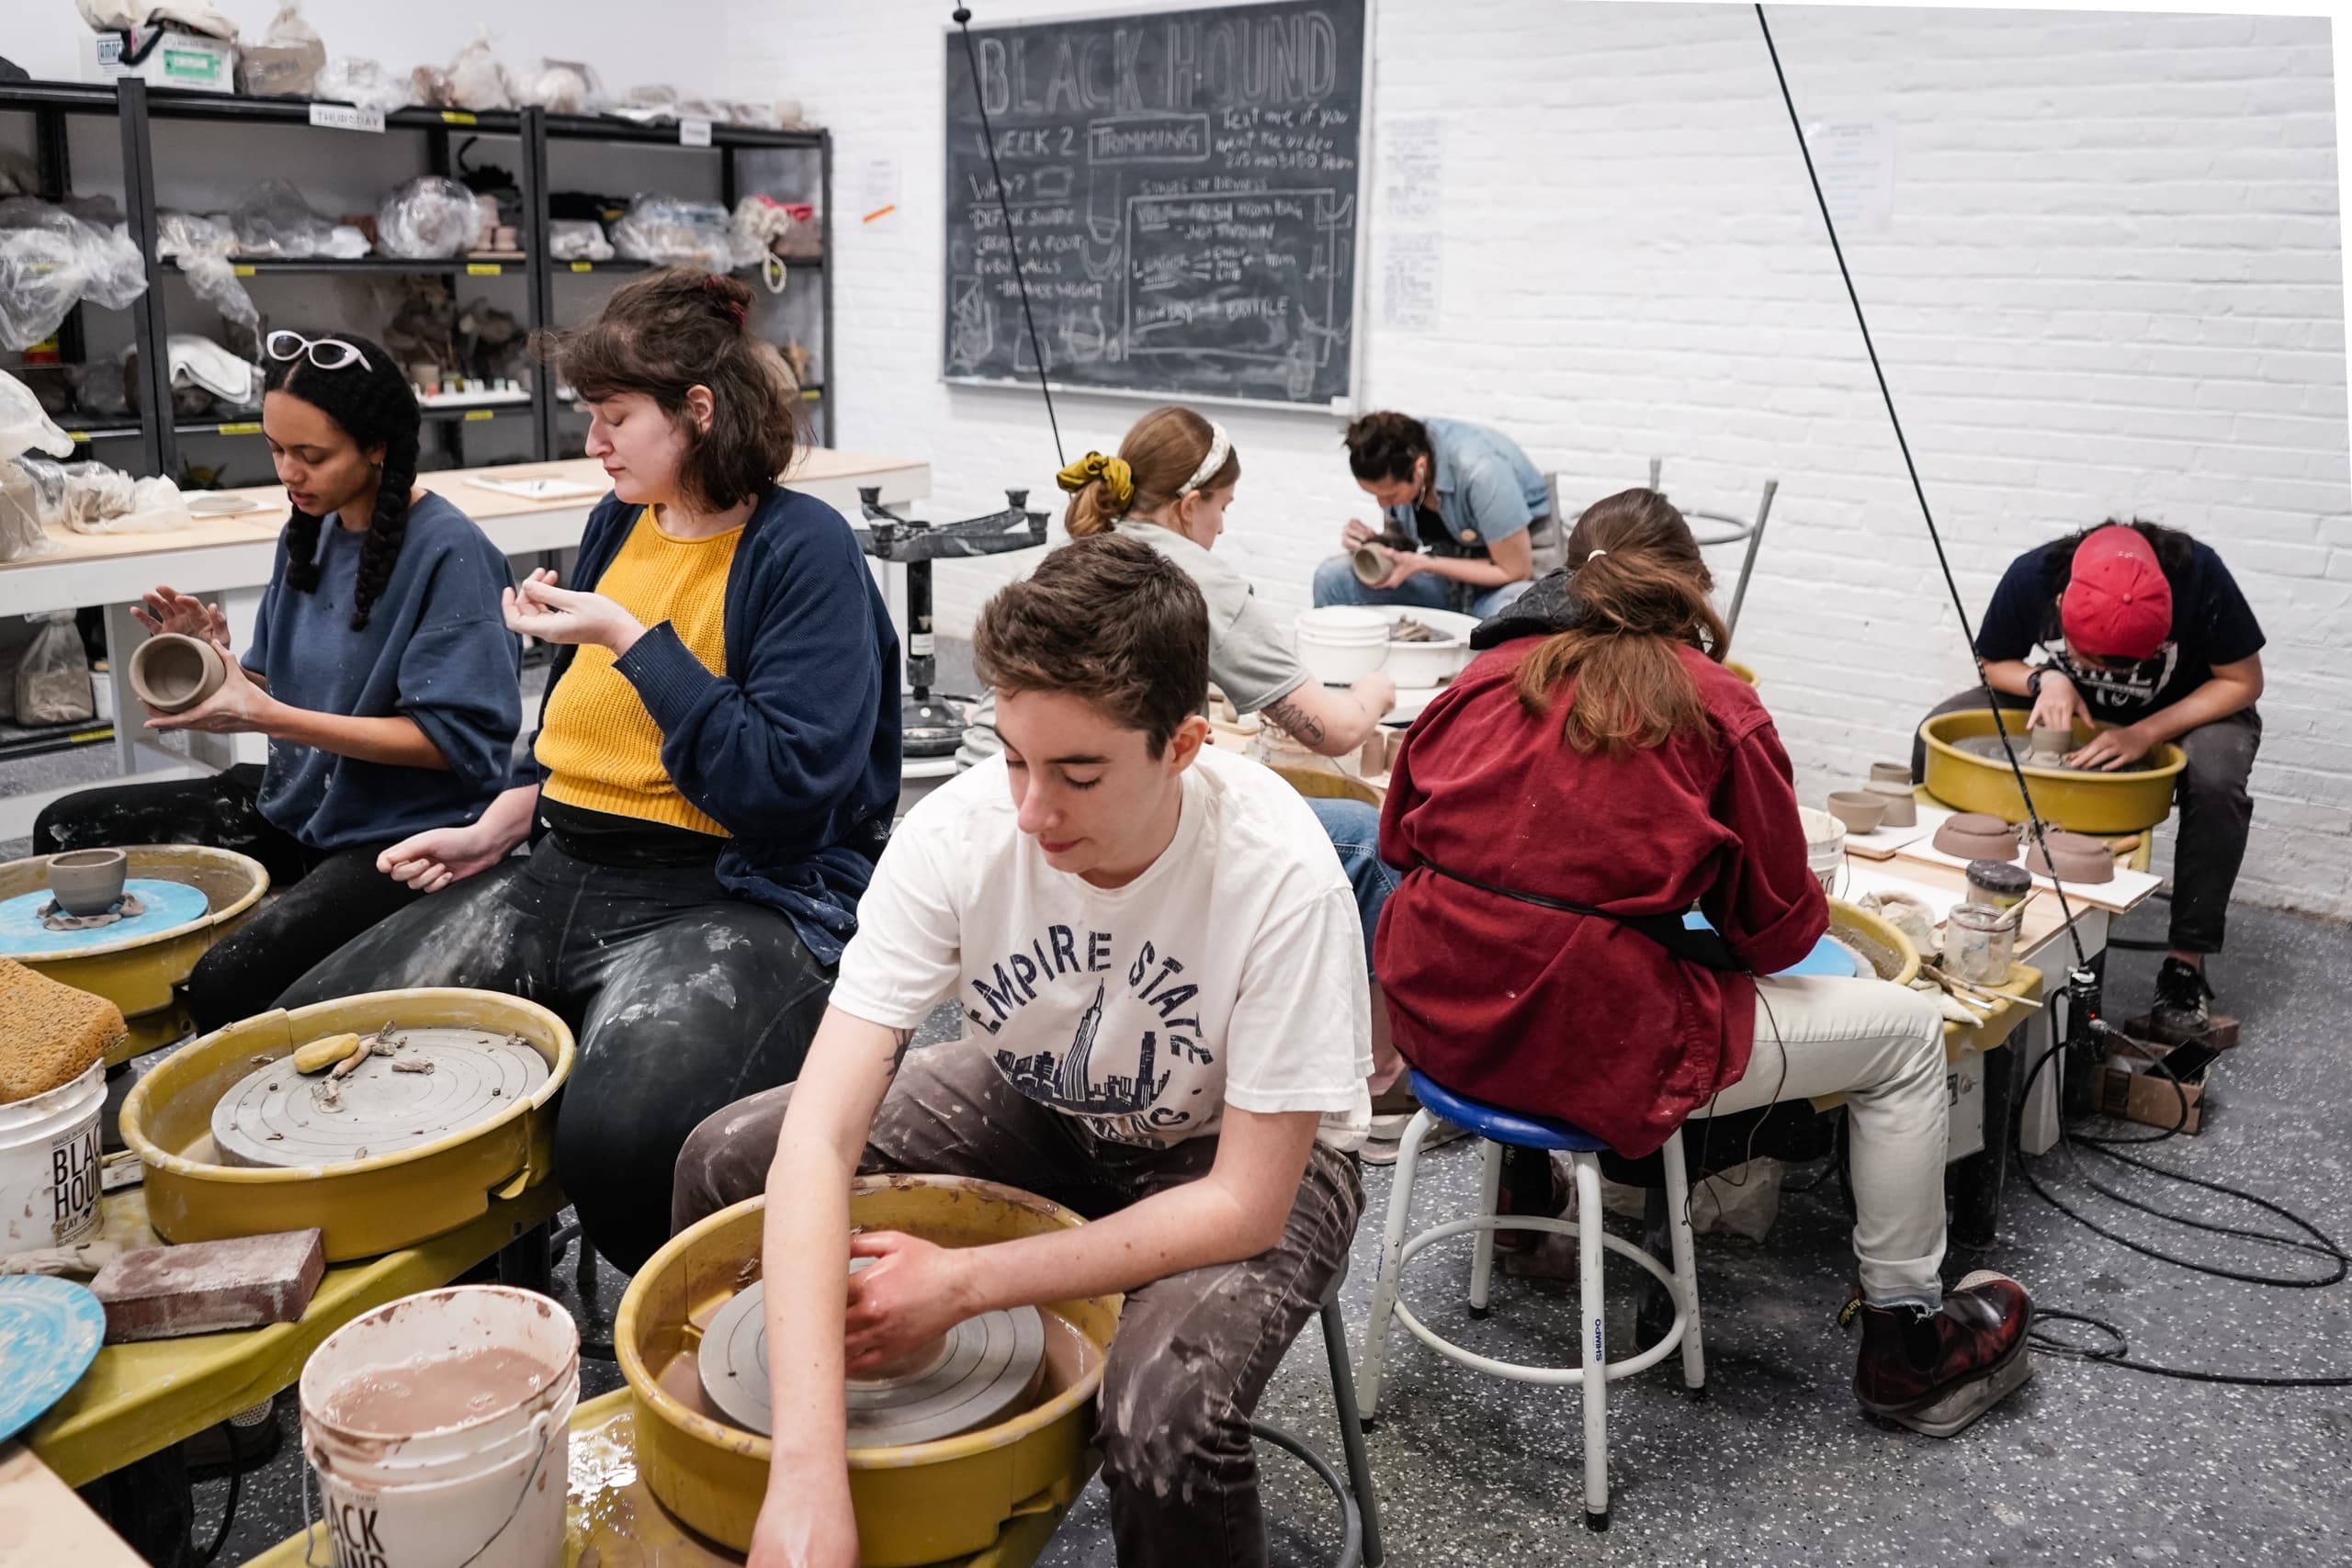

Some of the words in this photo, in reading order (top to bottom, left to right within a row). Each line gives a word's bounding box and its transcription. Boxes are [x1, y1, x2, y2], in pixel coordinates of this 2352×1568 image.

[978, 28, 1145, 115] BLACK
[1166, 11, 1337, 109] HOUND
[316, 109, 379, 127] THURSDAY
[975, 129, 1050, 162] WEEK
[1058, 126, 1078, 157] 2
[1091, 124, 1198, 155] TRIMMING
[962, 923, 1112, 1035] EMPIRE
[1129, 940, 1214, 1066] STATE
[1594, 1318, 1603, 1362] SHIMPO
